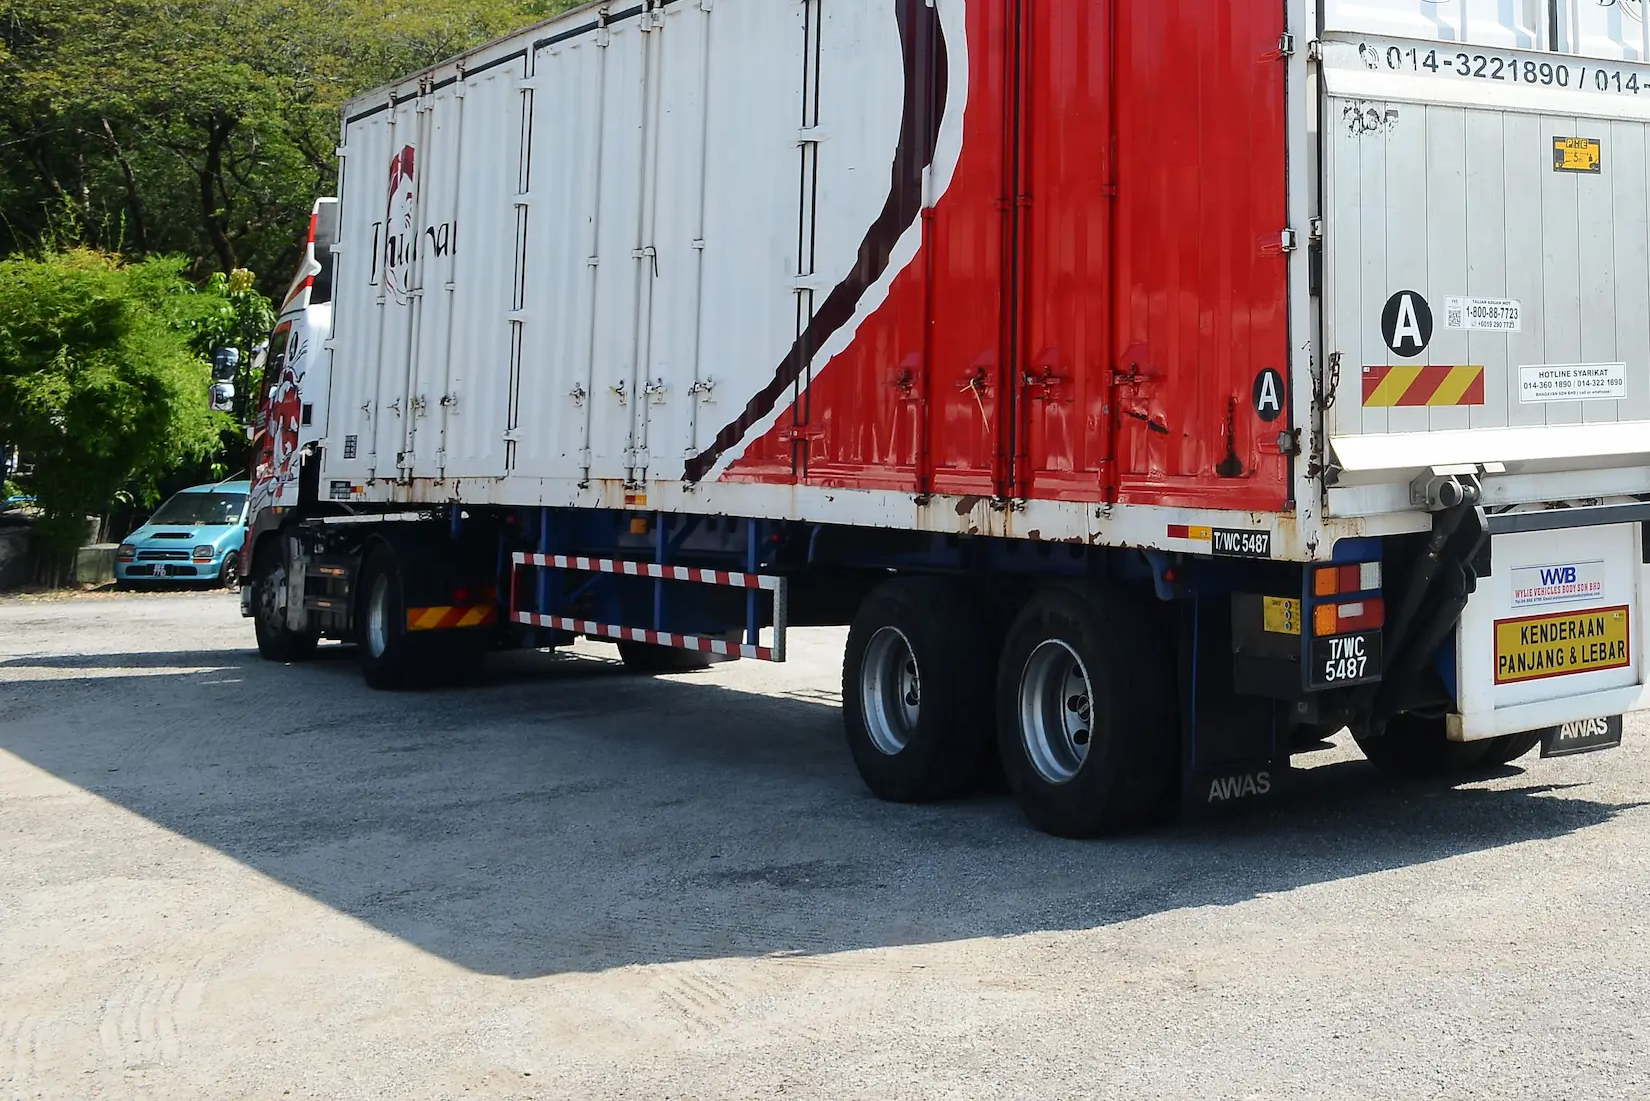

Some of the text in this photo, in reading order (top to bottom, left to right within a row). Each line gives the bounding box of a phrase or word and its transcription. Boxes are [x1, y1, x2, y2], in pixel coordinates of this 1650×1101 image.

[1386, 46, 1569, 87] 014-3221890
[1392, 294, 1423, 348] A
[1466, 305, 1518, 319] 1-800-88-7723
[1523, 381, 1552, 389] 014-360
[1555, 380, 1572, 388] 1890
[1577, 379, 1604, 387] 014-322
[1607, 378, 1622, 386] 1890
[1538, 369, 1608, 378] HOTLINE SYARIKAT
[1257, 371, 1279, 411] A
[1214, 531, 1269, 553] T/WC 5487
[1514, 588, 1533, 598] WYLIE
[1533, 585, 1561, 596] VEHICLES
[1562, 584, 1576, 594] BODY
[1577, 583, 1588, 592] SDN
[1589, 581, 1601, 591] BHD
[1520, 617, 1605, 646] KENDERAAN
[1328, 636, 1365, 660] T/WC
[1499, 640, 1626, 675] PANJANG & LEBAR
[1325, 656, 1367, 681] 5487
[1560, 716, 1608, 740] AWAS
[1207, 771, 1271, 802] AWAS
